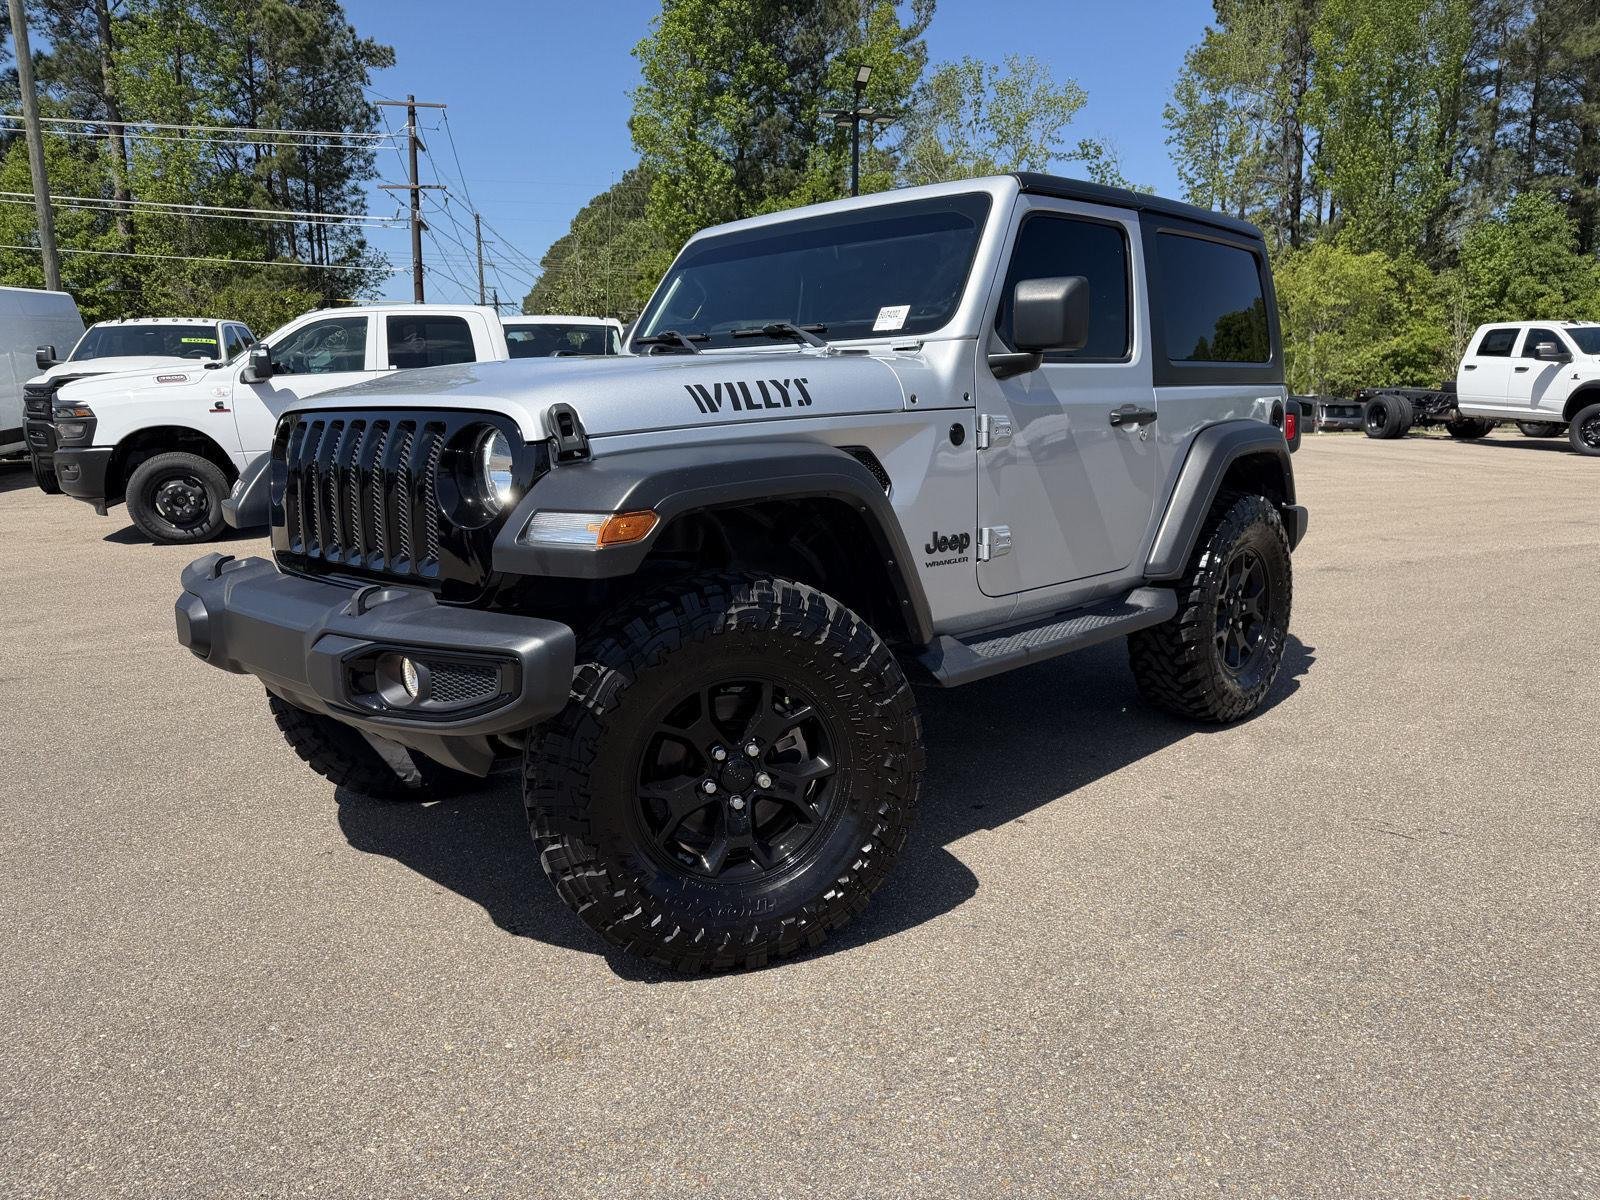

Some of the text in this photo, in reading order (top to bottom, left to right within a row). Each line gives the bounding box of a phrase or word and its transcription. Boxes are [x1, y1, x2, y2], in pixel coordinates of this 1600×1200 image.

[684, 378, 812, 413] WILLYS
[925, 531, 971, 554] Jeep
[925, 556, 969, 568] WRANGLER
